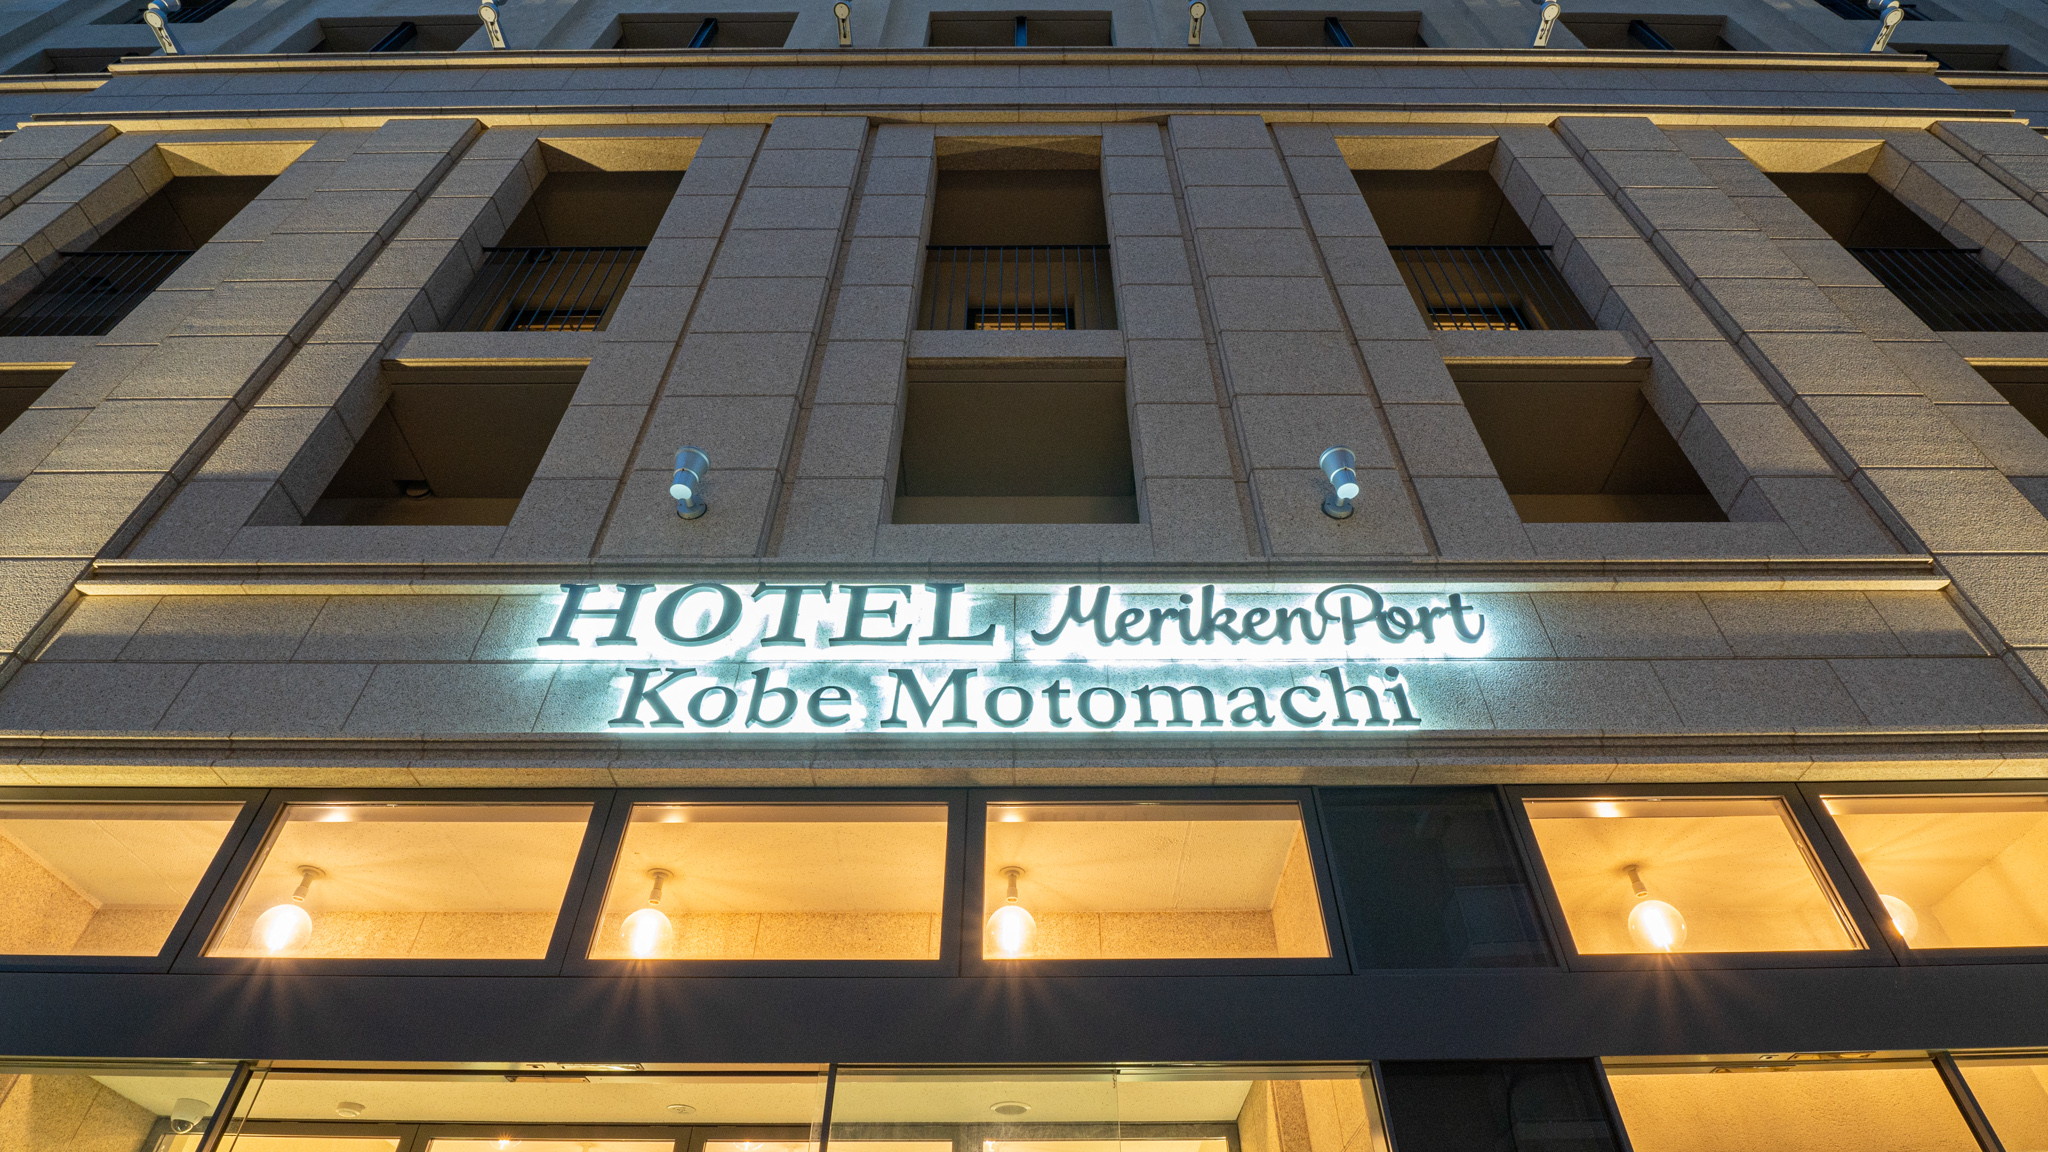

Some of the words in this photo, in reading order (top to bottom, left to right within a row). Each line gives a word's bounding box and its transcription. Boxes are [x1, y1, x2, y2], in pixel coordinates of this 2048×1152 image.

[537, 581, 996, 647] HOTEL
[1031, 585, 1329, 646] Meriken
[1314, 584, 1485, 646] Port
[608, 667, 851, 728] Kobe
[880, 666, 1422, 728] Motomachi
